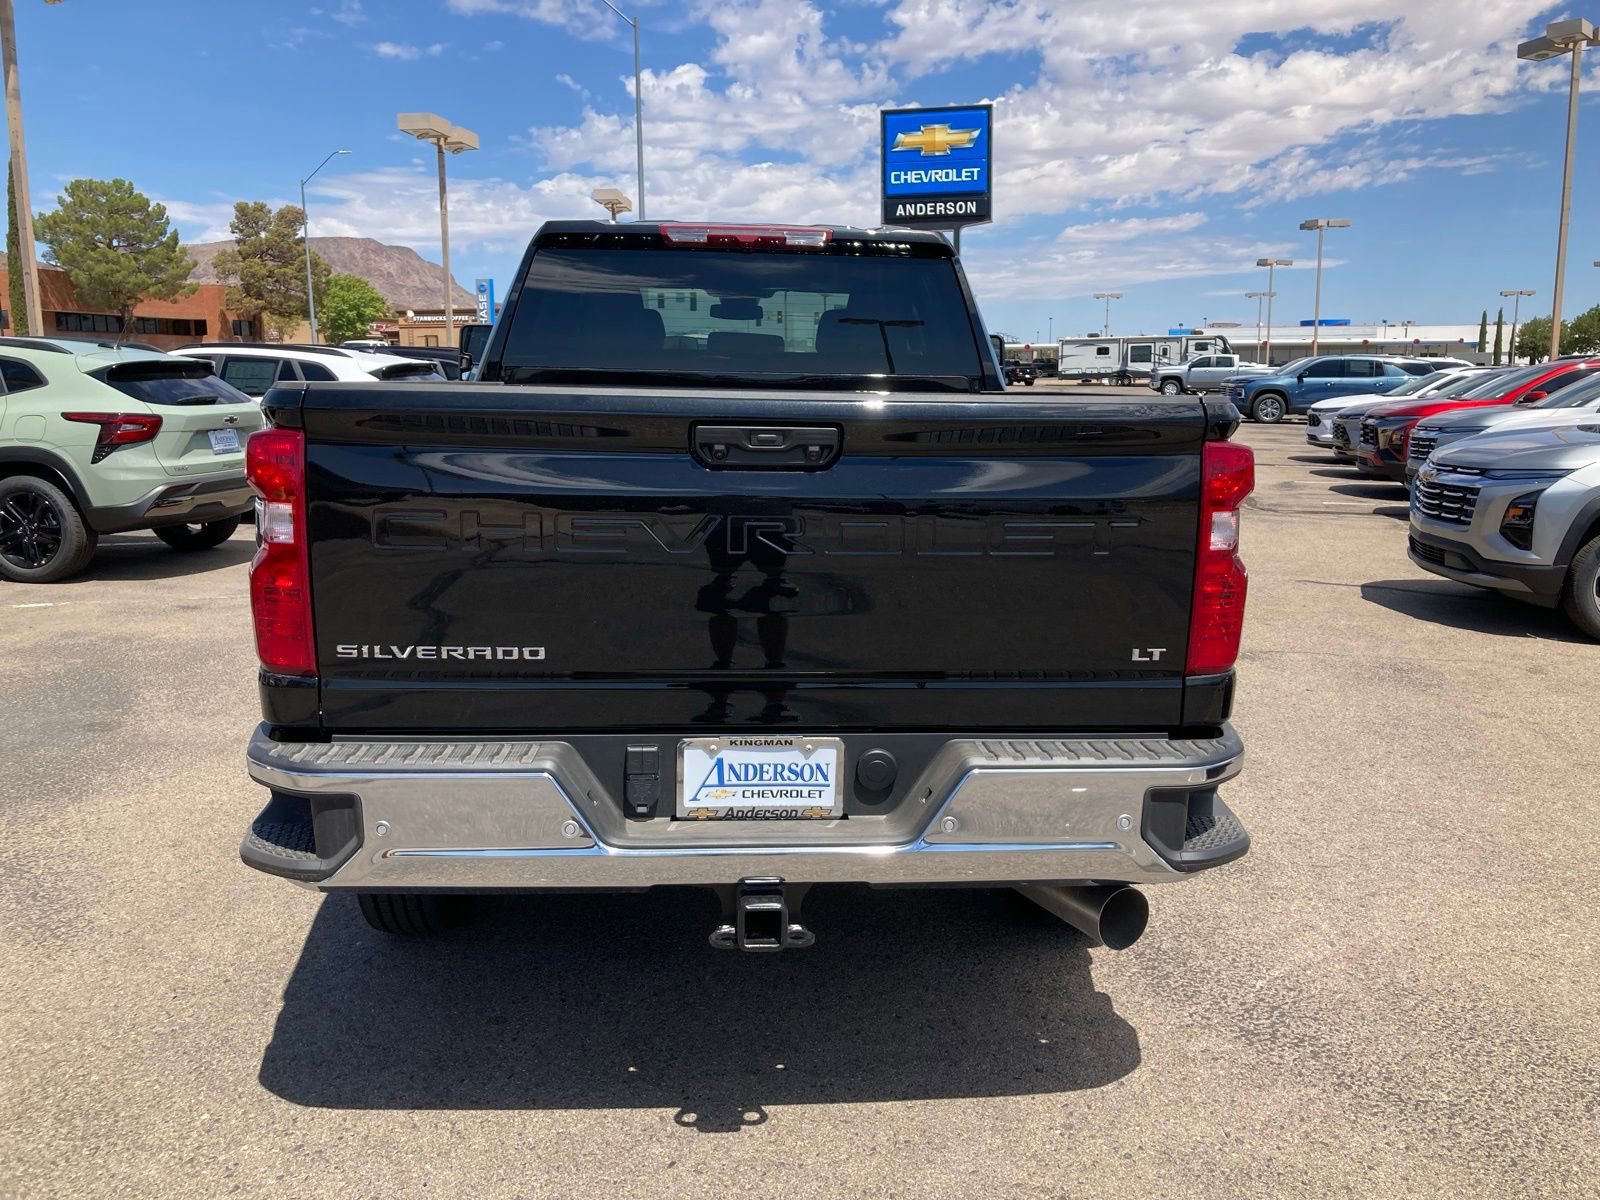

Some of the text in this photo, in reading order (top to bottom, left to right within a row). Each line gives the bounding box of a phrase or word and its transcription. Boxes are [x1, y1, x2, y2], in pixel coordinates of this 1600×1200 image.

[890, 168, 980, 184] CHEVROLET
[896, 201, 976, 216] ANDERSON
[479, 294, 487, 324] HASE
[370, 508, 1142, 556] CHEVROLET
[336, 644, 546, 660] SILVERADO
[1131, 647, 1167, 661] LT
[729, 739, 794, 747] KINGMAN
[689, 757, 830, 801] ANDERSON
[742, 789, 824, 799] CHEVROLET
[723, 807, 799, 820] Anderson
